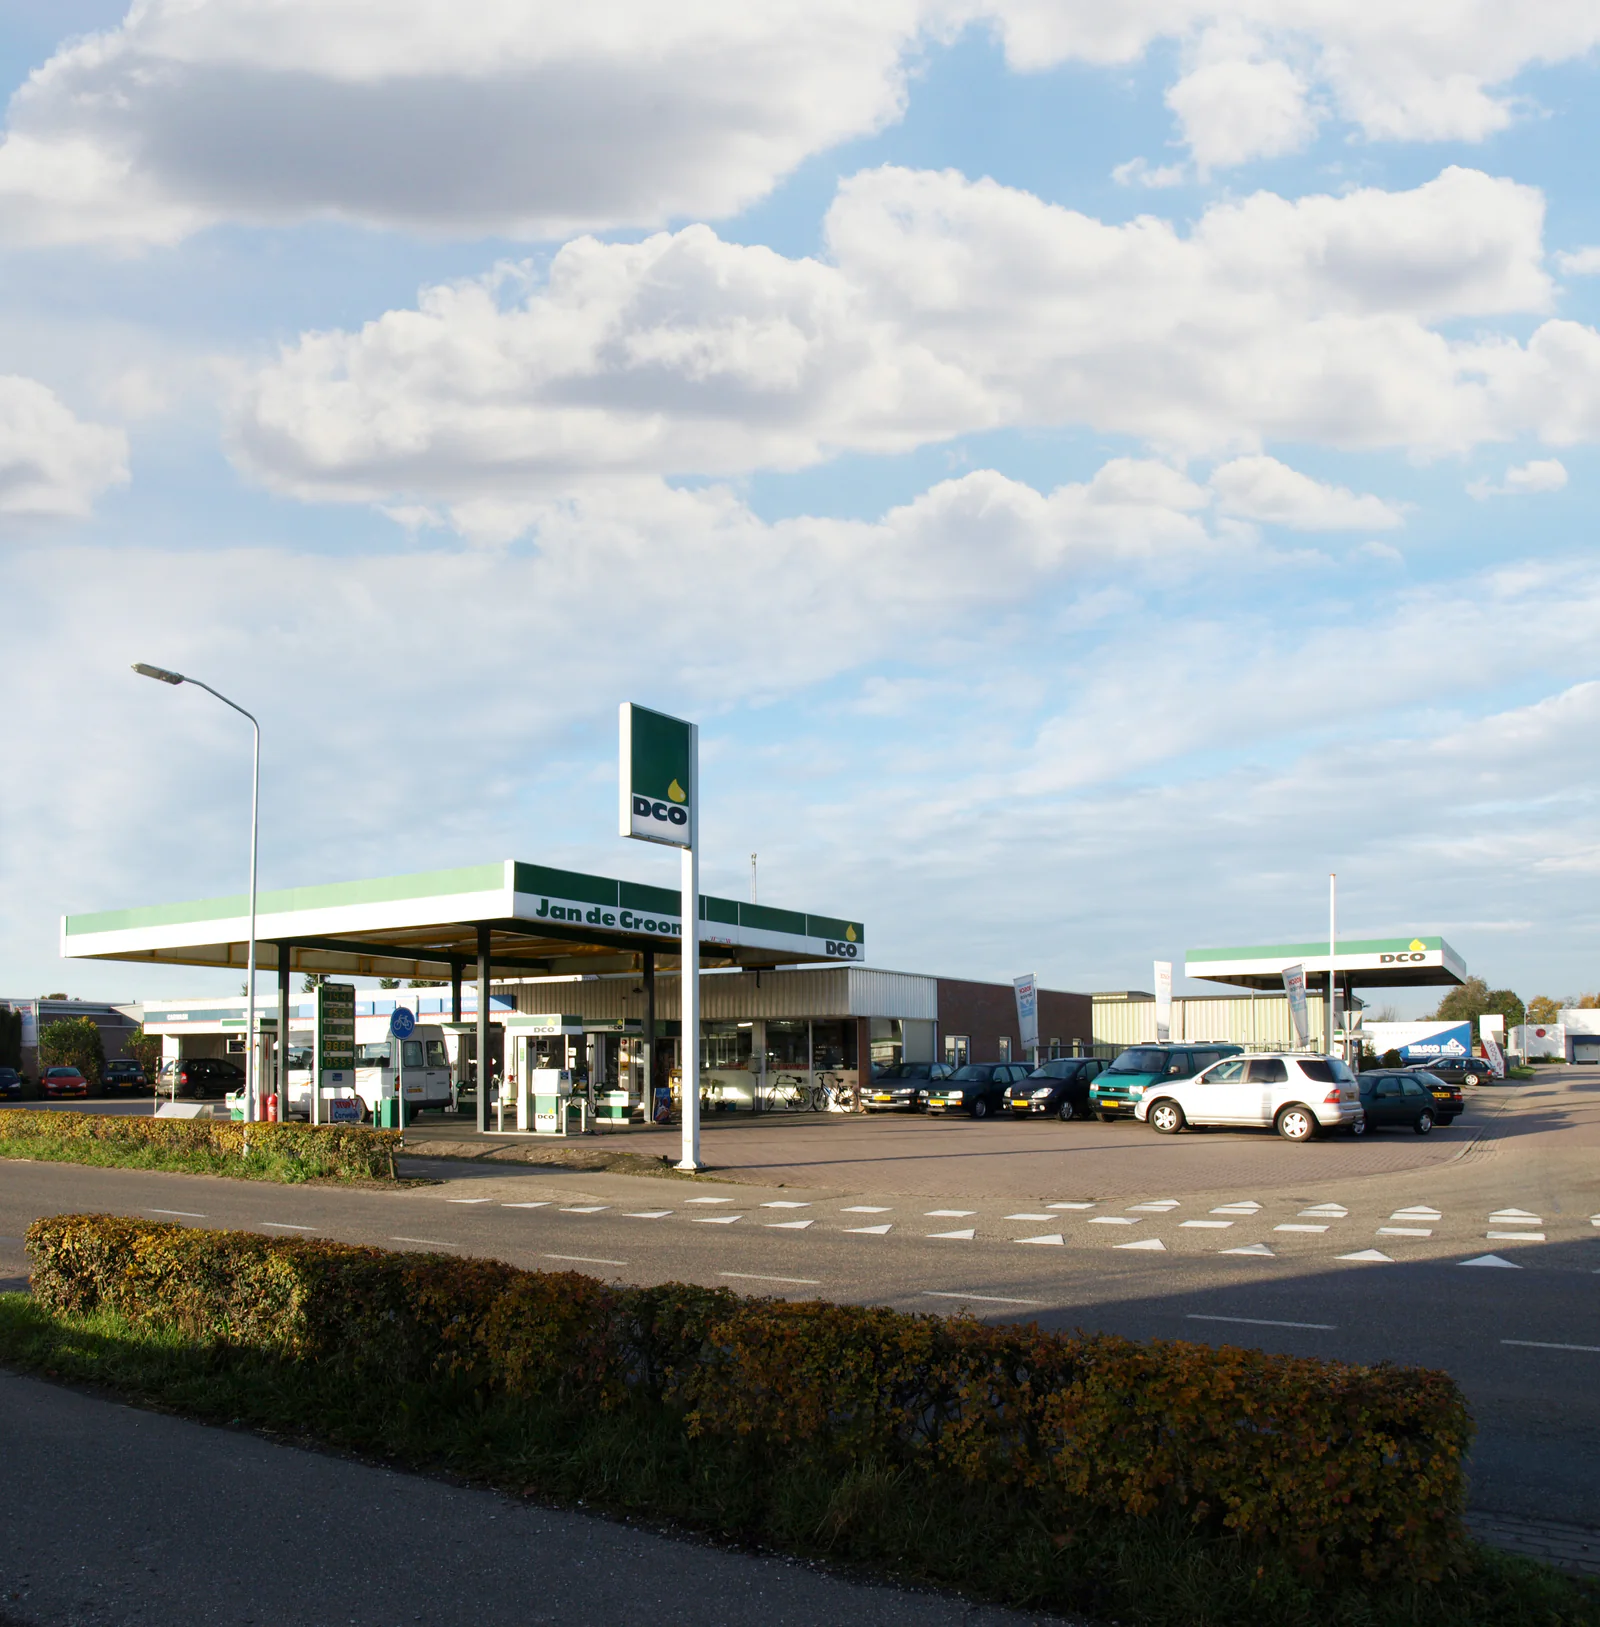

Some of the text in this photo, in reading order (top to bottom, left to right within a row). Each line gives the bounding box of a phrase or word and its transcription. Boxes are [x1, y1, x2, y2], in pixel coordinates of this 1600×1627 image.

[633, 796, 687, 825] DCO
[536, 899, 582, 922] Jan
[586, 907, 616, 926] de
[826, 941, 857, 957] DCO
[1380, 953, 1426, 963] DCO
